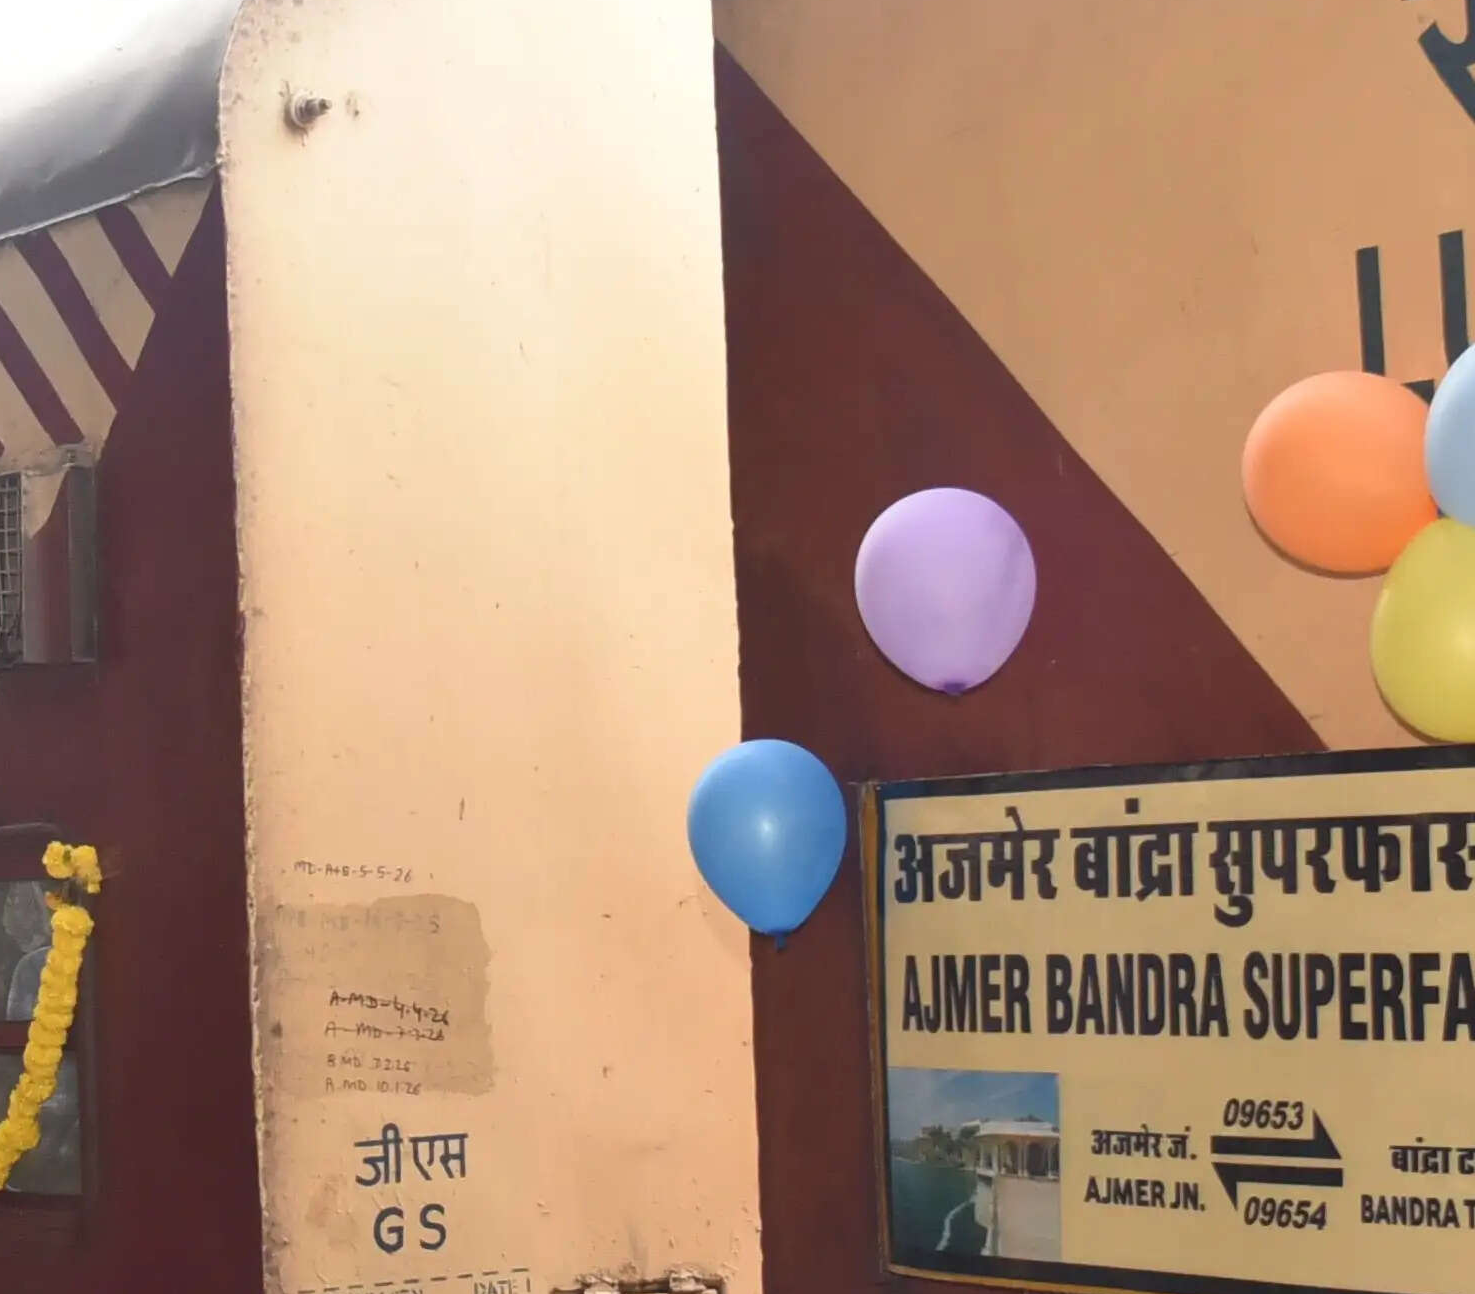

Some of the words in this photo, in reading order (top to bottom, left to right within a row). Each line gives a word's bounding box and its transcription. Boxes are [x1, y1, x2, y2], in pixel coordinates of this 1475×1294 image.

[893, 806, 1060, 903] अजमेर
[1070, 797, 1199, 901] बांद्रा
[901, 954, 1032, 1034] AJMER
[1046, 953, 1230, 1038] BANDRA
[1222, 1097, 1305, 1131] 09653
[354, 1122, 404, 1187] जी
[409, 1133, 469, 1181] एस
[1090, 1123, 1162, 1158] अजमेर
[1165, 1126, 1198, 1161] जं.
[1388, 1136, 1451, 1174] बांद्रा
[1083, 1176, 1166, 1209] AJMER
[1169, 1181, 1205, 1212] JN.
[1360, 1194, 1460, 1229] BANDRA
[1243, 1196, 1327, 1231] 09654
